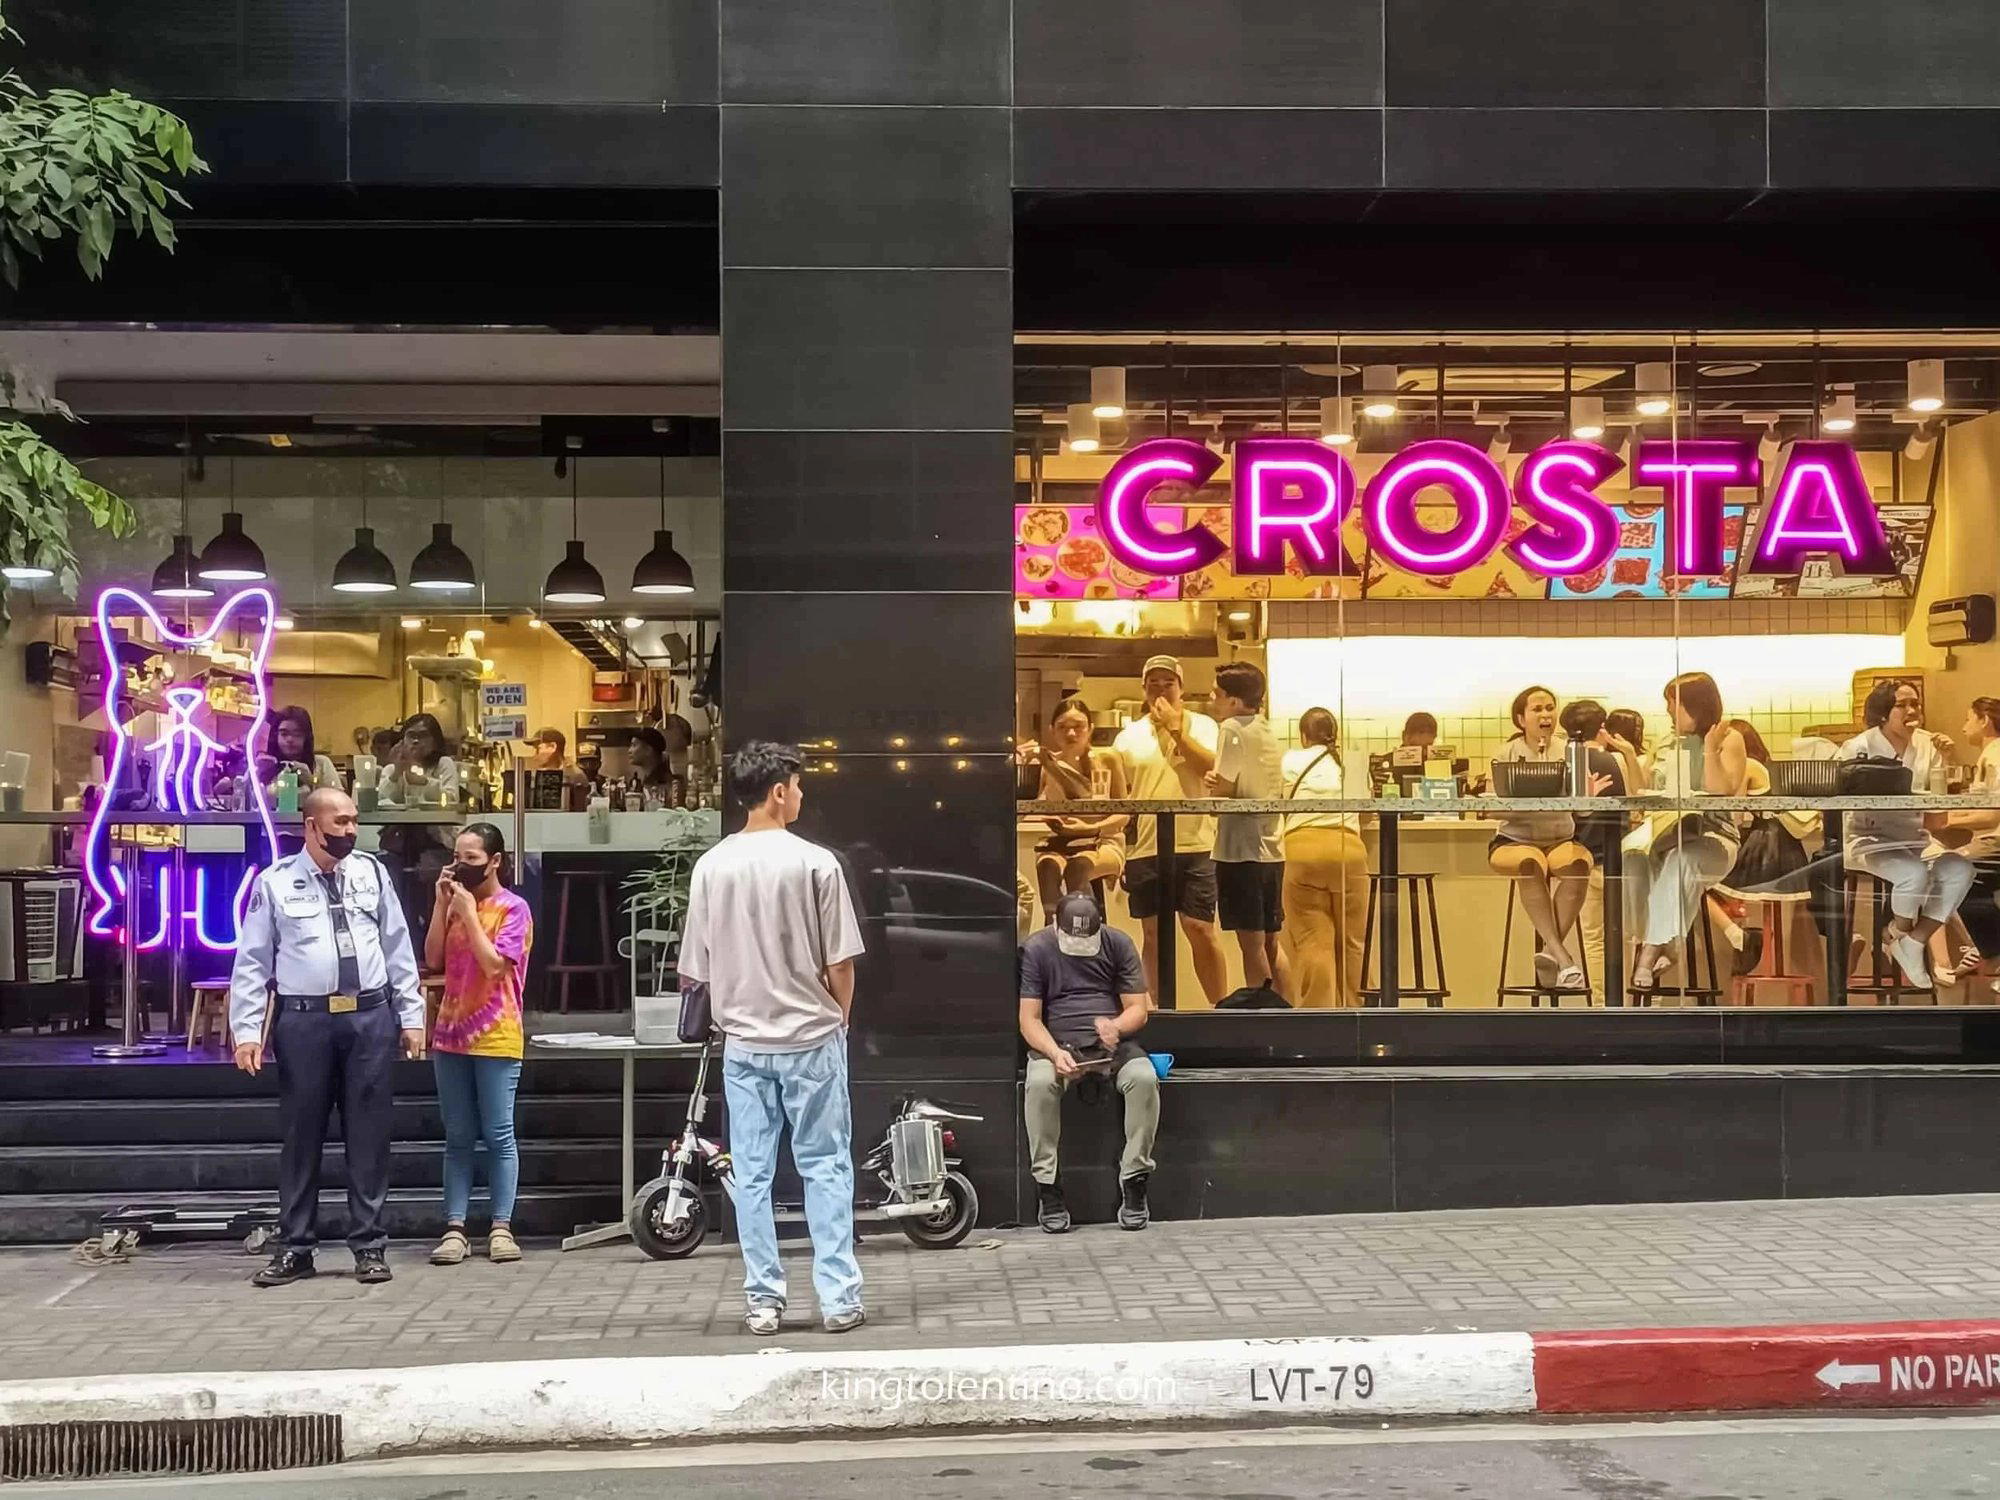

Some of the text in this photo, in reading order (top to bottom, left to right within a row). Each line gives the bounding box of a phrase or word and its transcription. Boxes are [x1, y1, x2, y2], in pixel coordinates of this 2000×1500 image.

[1098, 438, 1888, 578] CROSTA
[486, 695, 522, 704] OPEN
[1250, 1364, 1374, 1402] LVT-79
[1891, 1354, 2000, 1391] NO PAR
